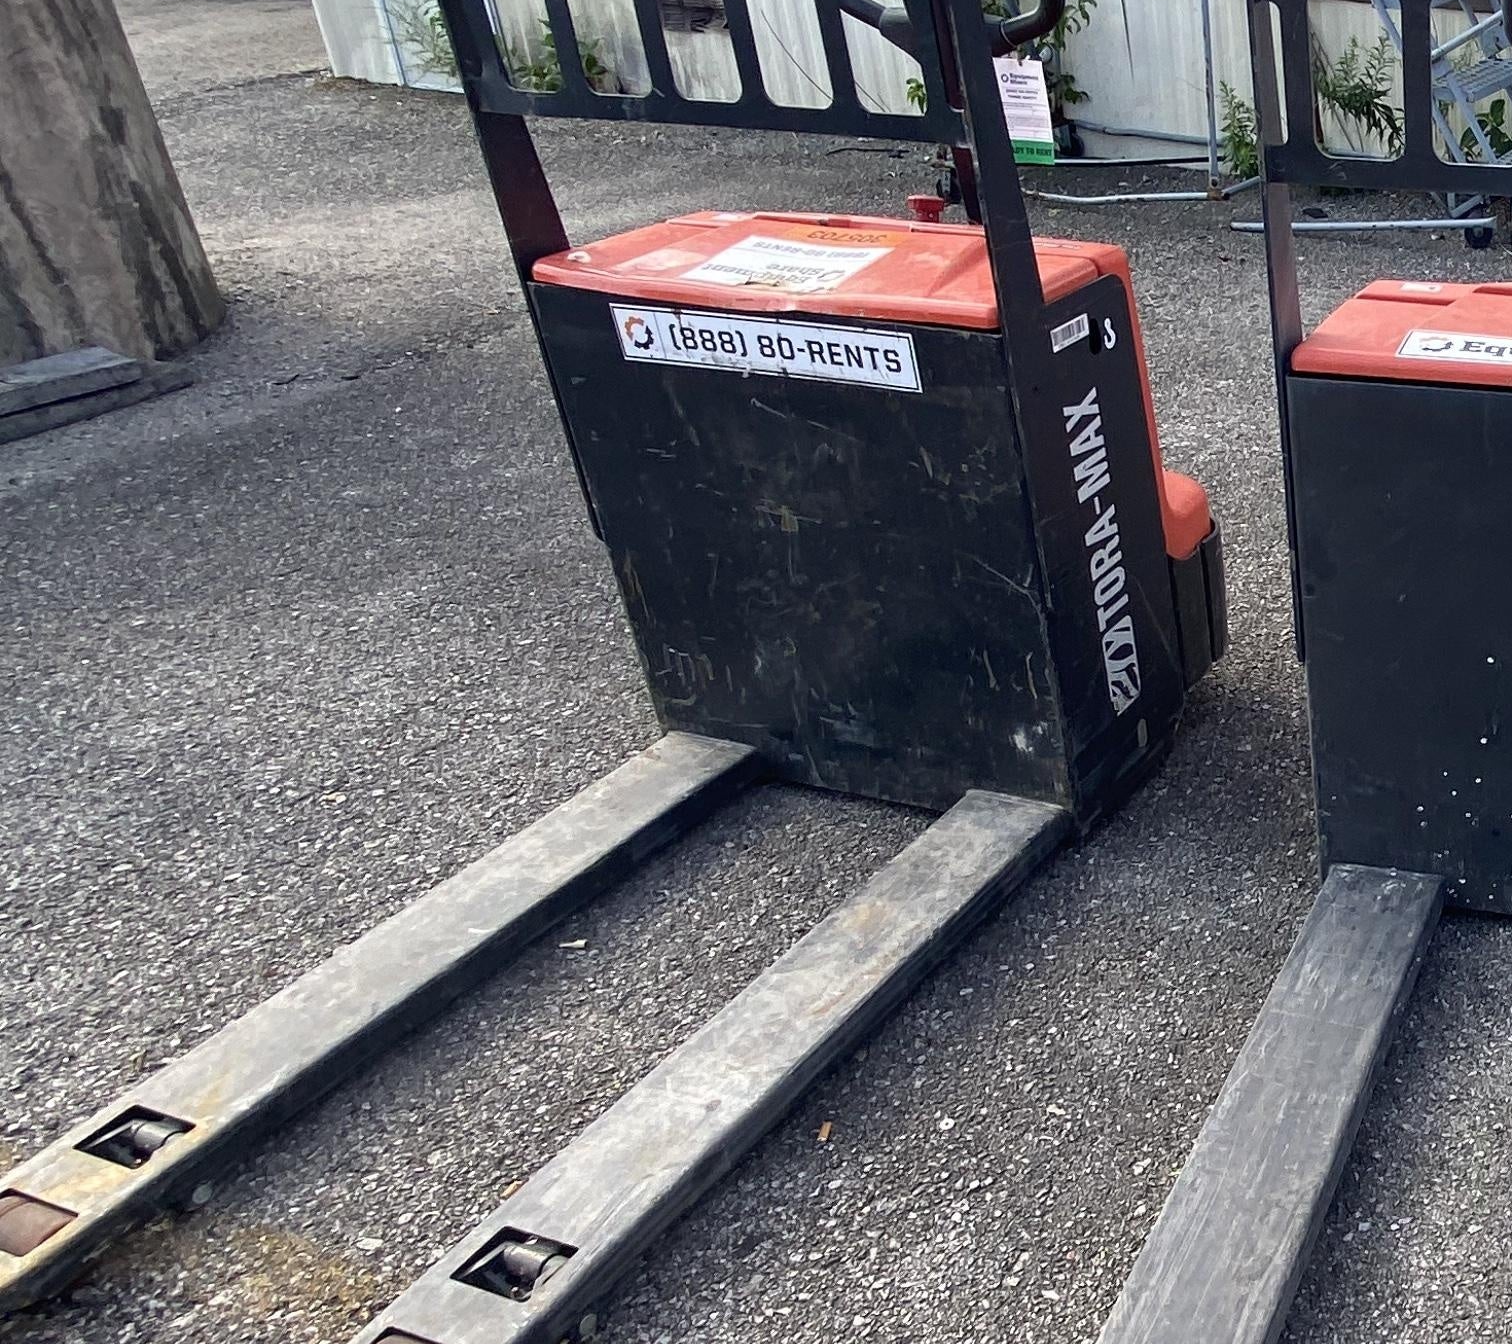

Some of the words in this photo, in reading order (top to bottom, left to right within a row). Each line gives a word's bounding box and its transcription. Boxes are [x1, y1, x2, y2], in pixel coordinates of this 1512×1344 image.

[669, 323, 748, 357] (888)
[756, 334, 902, 373] 80-RENTS
[1063, 386, 1130, 633] TORA-MAX
